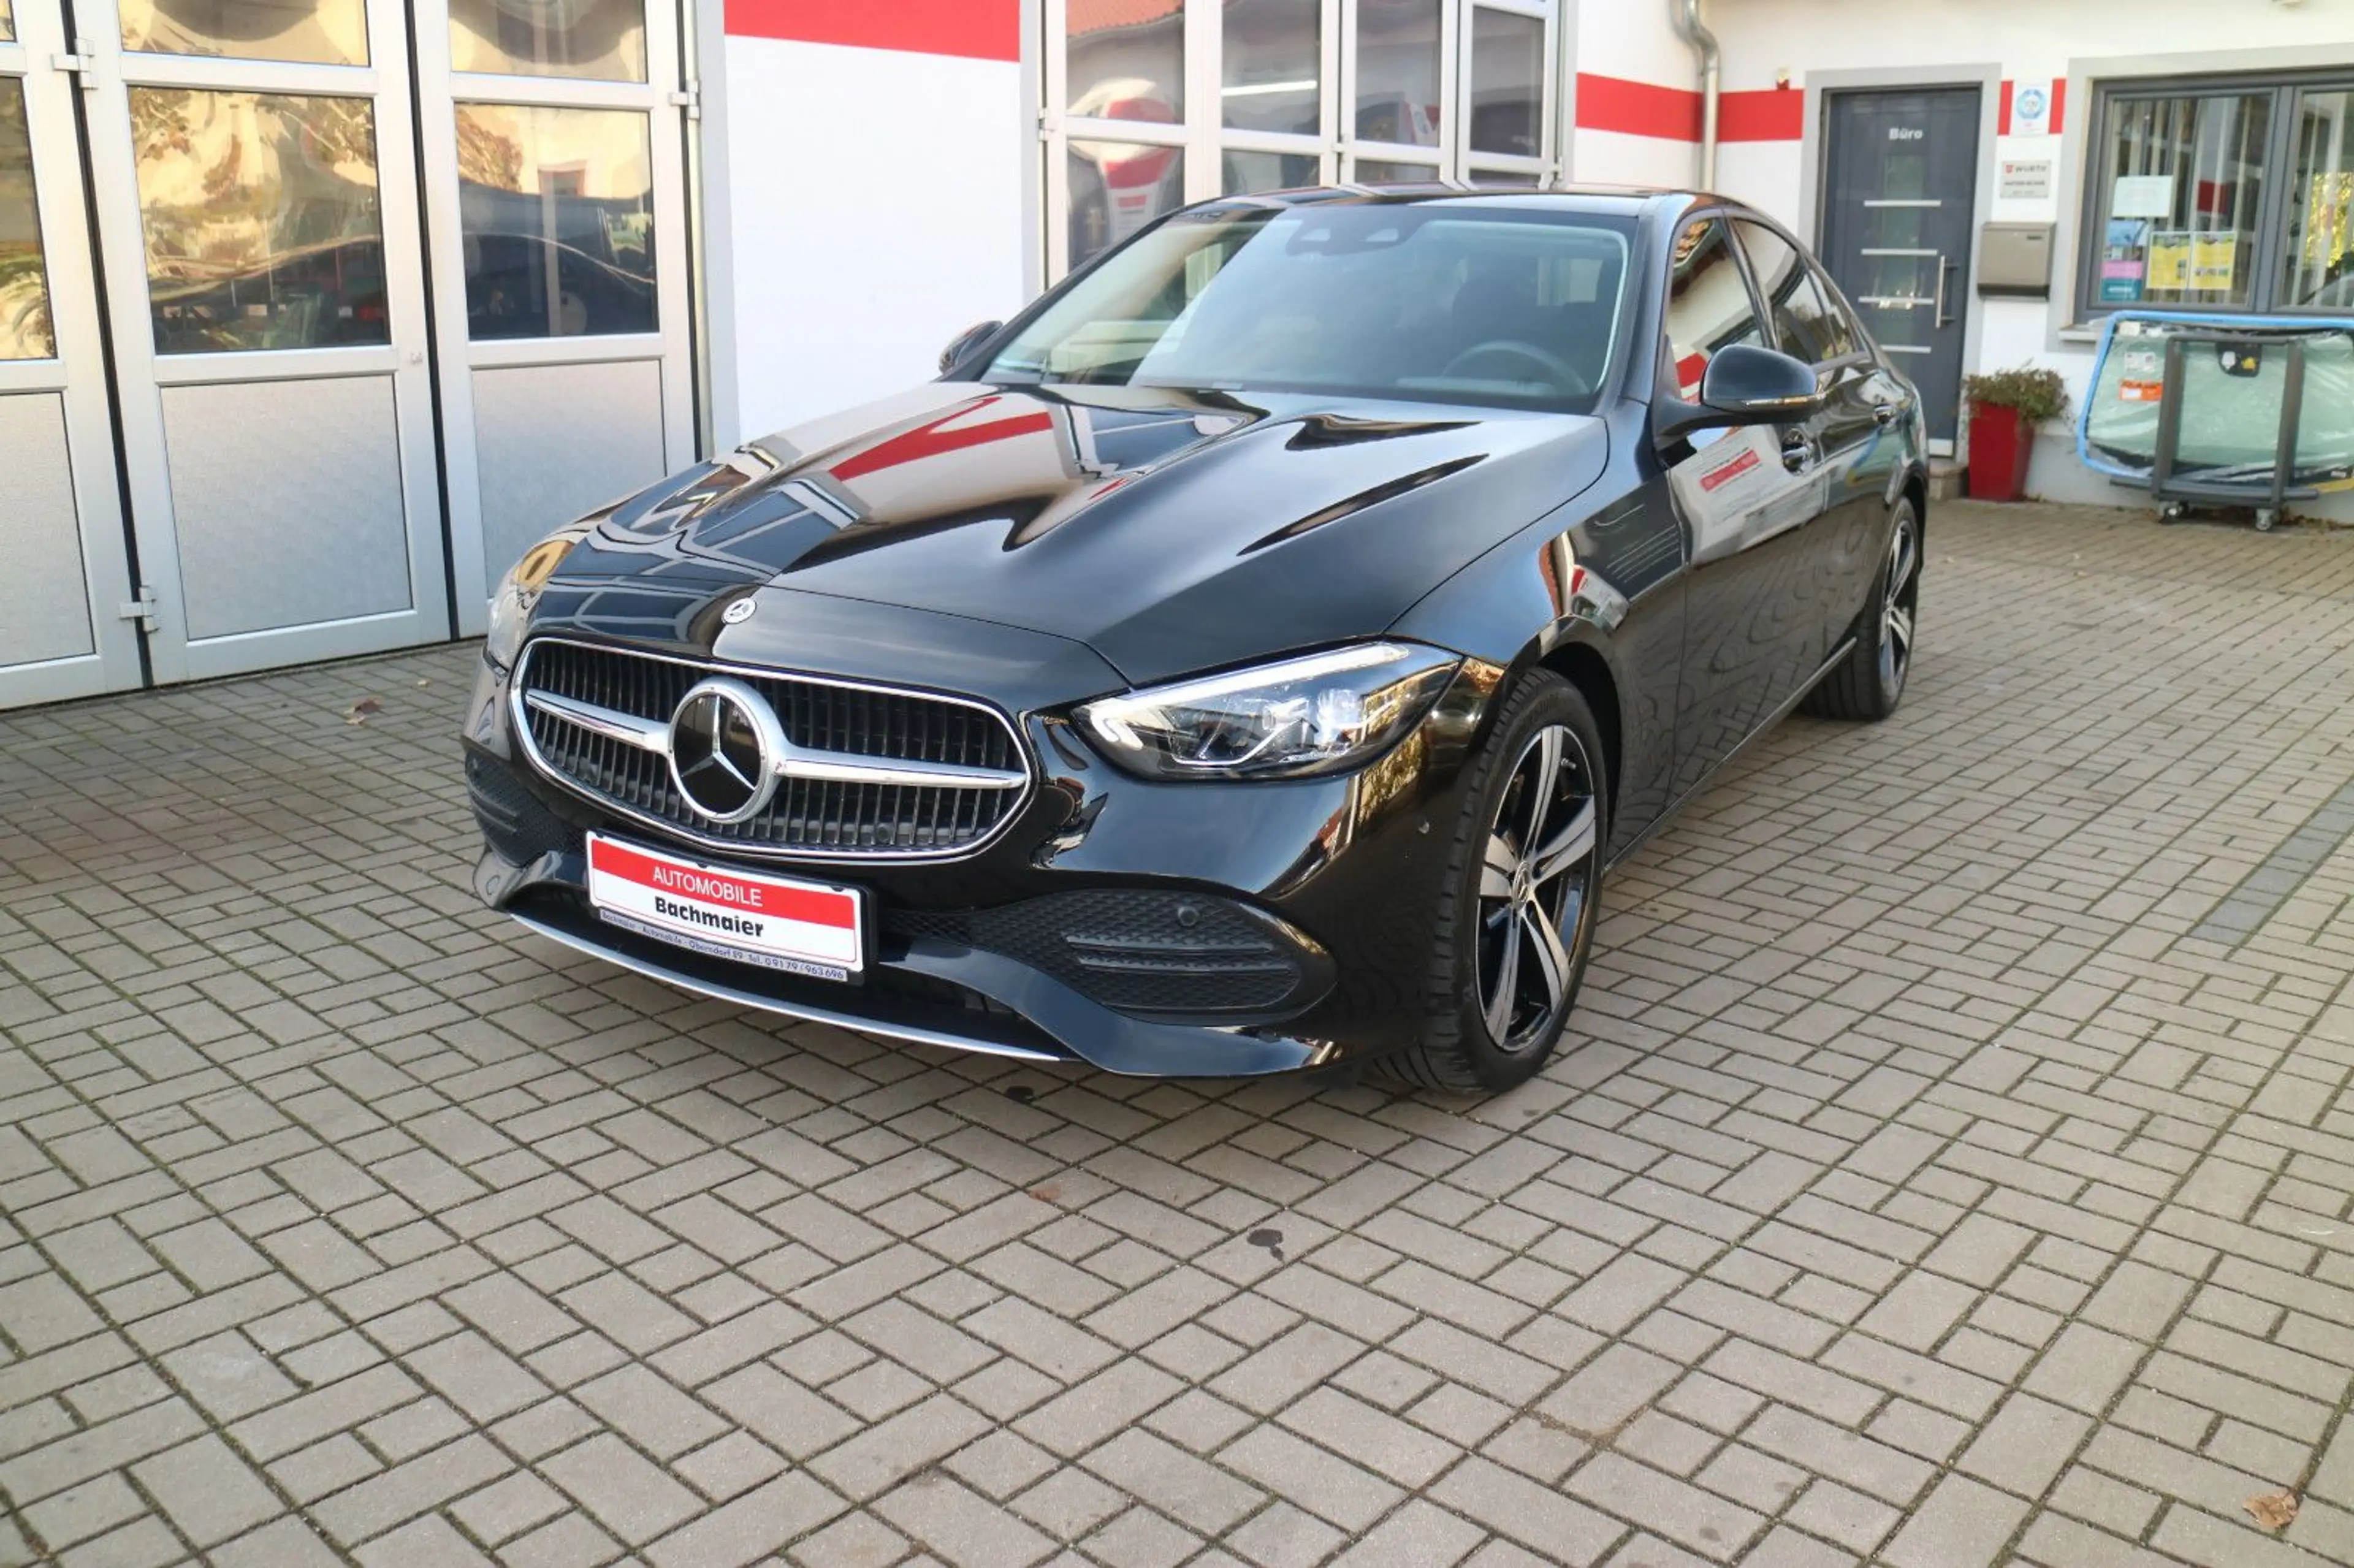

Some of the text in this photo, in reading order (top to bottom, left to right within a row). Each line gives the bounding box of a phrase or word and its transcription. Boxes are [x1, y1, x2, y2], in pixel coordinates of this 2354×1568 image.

[1889, 127, 1923, 140] Büro
[653, 866, 763, 907] AUTOMOBILE
[655, 896, 764, 937] Bachmaier
